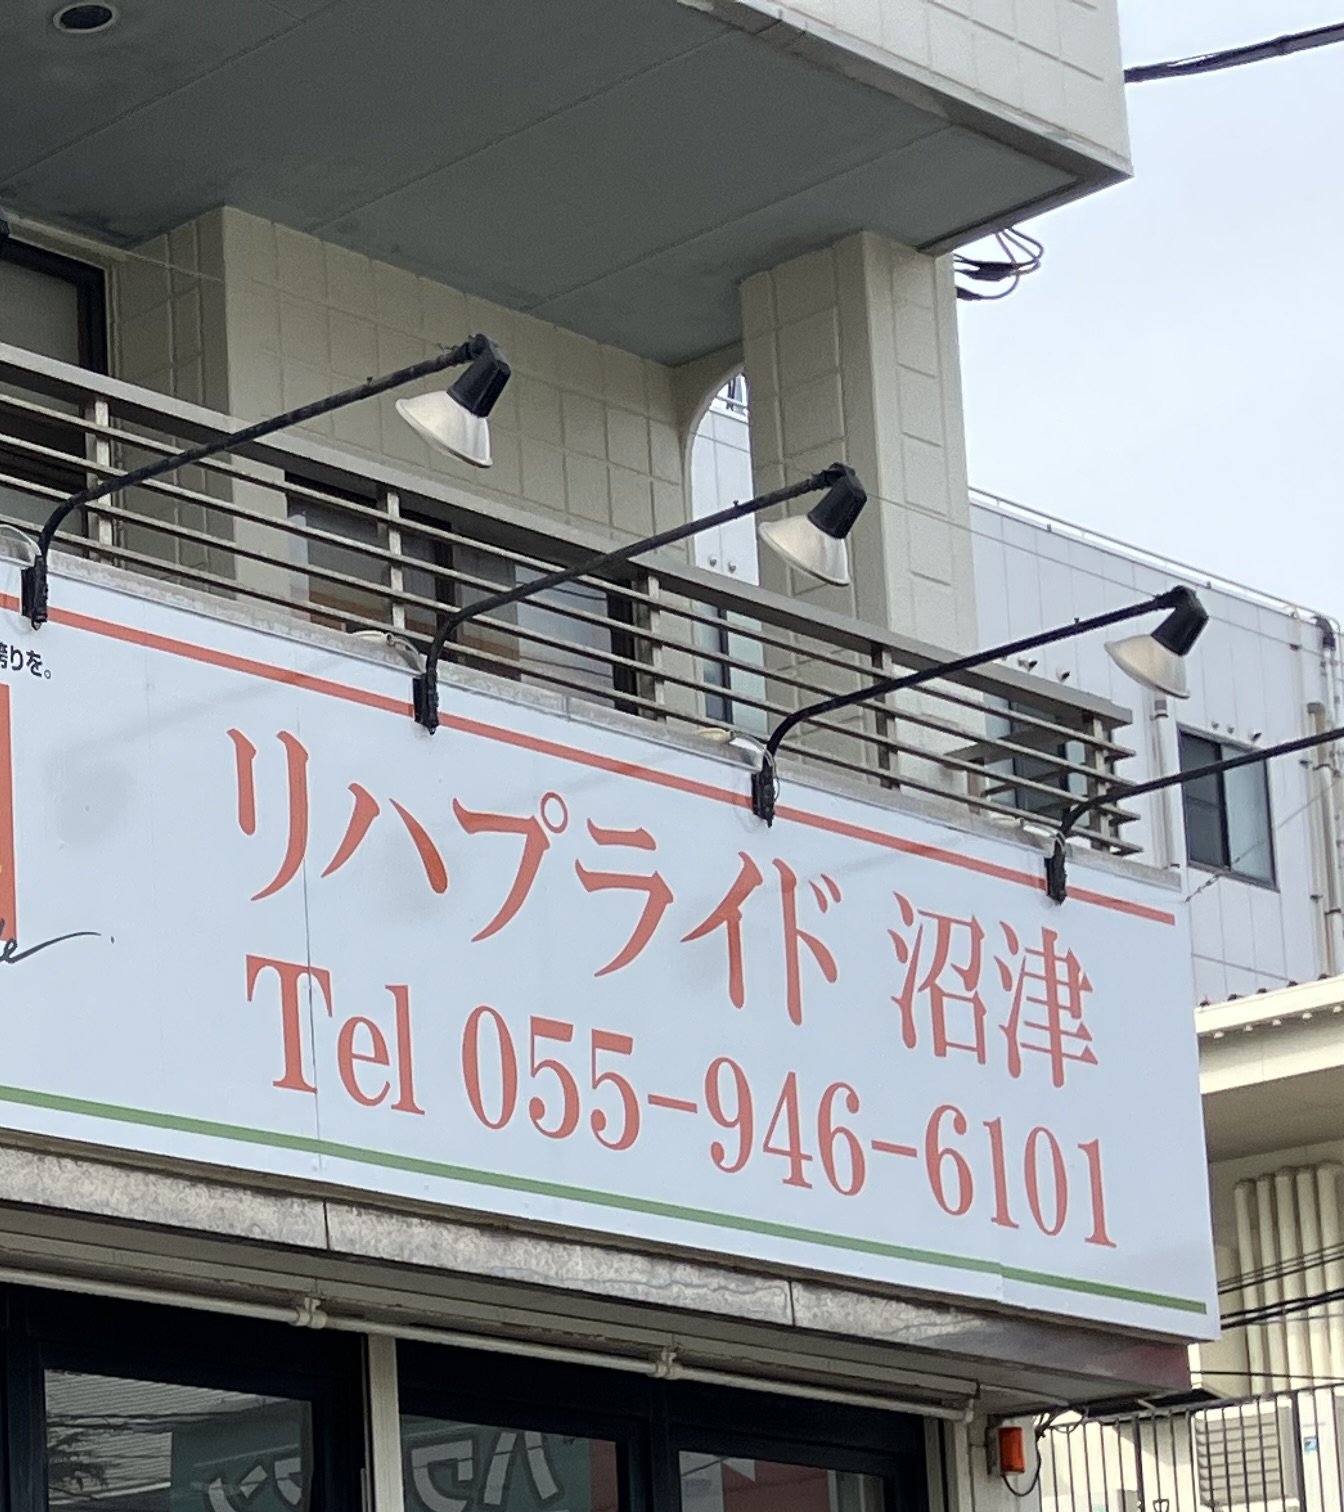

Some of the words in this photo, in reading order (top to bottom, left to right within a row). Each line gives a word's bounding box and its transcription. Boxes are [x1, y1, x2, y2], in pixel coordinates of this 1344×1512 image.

[226, 728, 844, 1026] リハプライド
[888, 891, 1099, 1089] 沼津
[246, 953, 426, 1115] Tel
[461, 1003, 1118, 1248] 055-946-6101
